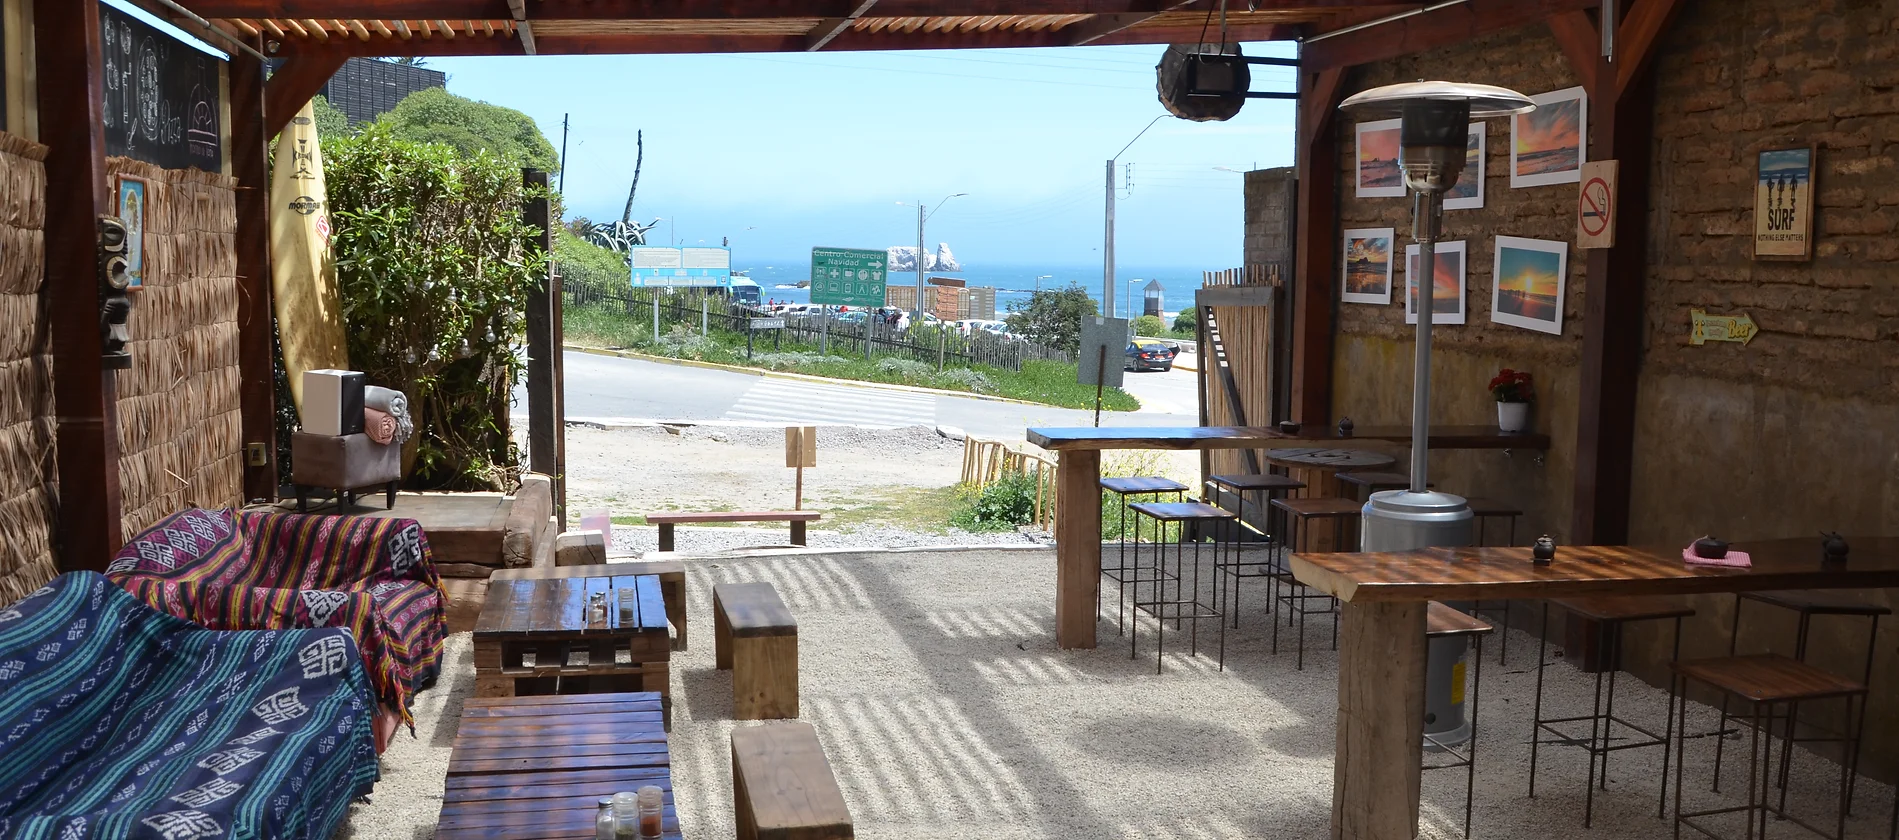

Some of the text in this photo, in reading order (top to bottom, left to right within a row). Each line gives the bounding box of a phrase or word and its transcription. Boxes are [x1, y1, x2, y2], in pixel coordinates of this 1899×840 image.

[1767, 208, 1795, 231] SURF
[1757, 233, 1804, 242] NOTHING ELSE MATTERS
[813, 249, 884, 260] Centro Comercial
[827, 258, 860, 266] Navidad
[1727, 319, 1752, 339] Beer
